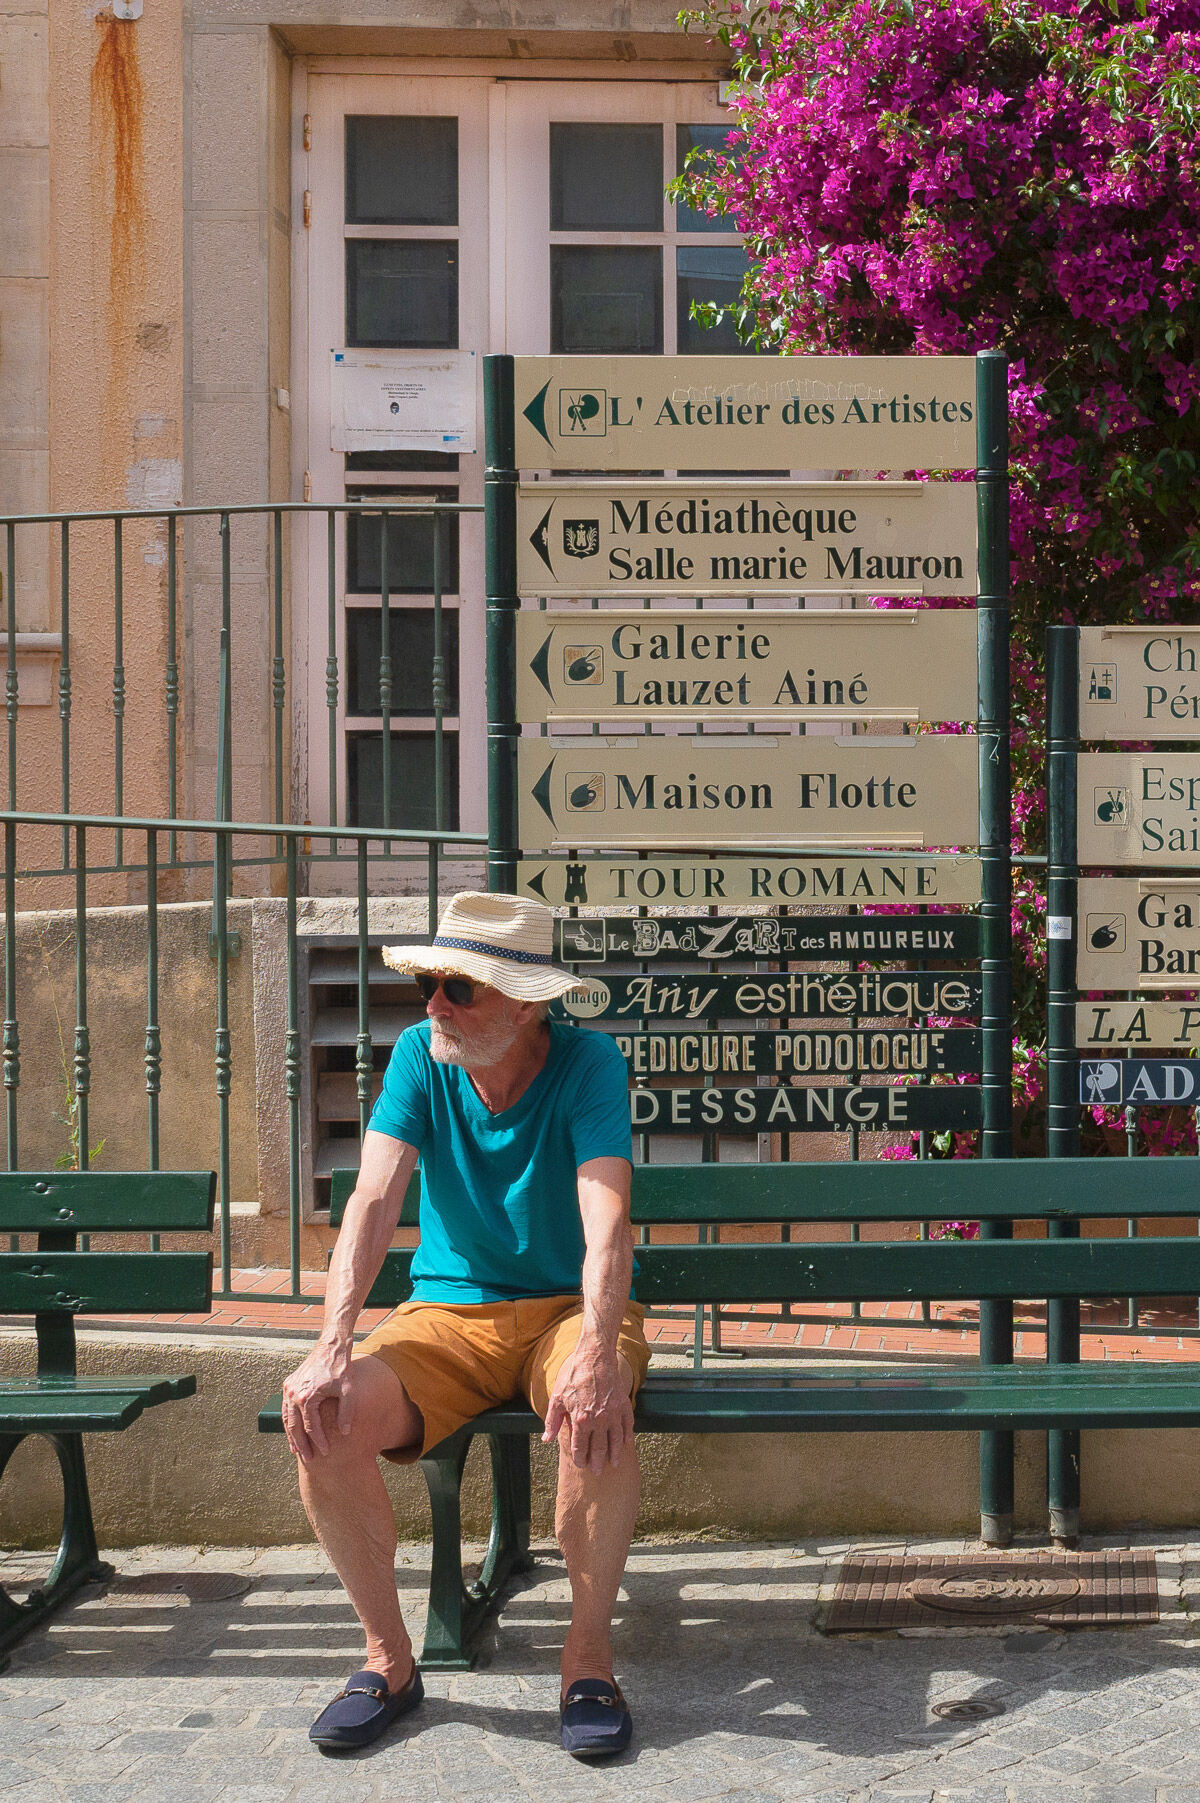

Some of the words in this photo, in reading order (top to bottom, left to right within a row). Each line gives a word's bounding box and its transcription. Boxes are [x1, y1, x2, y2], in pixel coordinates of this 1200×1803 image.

[653, 396, 771, 426] Atelier
[781, 396, 835, 426] des
[841, 393, 973, 424] Artistes
[608, 498, 857, 542] Médiathèque
[608, 547, 694, 581] Salle
[709, 546, 807, 580] marie
[824, 546, 965, 580] Mauron
[612, 624, 771, 660] Galerie
[611, 670, 751, 706] Lauzet
[771, 668, 868, 705] Ainé
[613, 773, 773, 810] Maison
[797, 773, 917, 809] Flotte
[609, 867, 729, 899] TOUR
[748, 866, 938, 898] ROMANE
[607, 933, 630, 951] Le
[800, 936, 826, 949] des
[829, 930, 955, 949] AMOUREUX
[616, 977, 719, 1018] Any
[735, 975, 971, 1018] esthétique
[1086, 1007, 1152, 1043] LA
[616, 1036, 756, 1072] PEDICURE
[775, 1033, 945, 1071] PODOLOGUE
[630, 1087, 908, 1124] DESSANGE
[834, 1122, 889, 1132] PARIS
